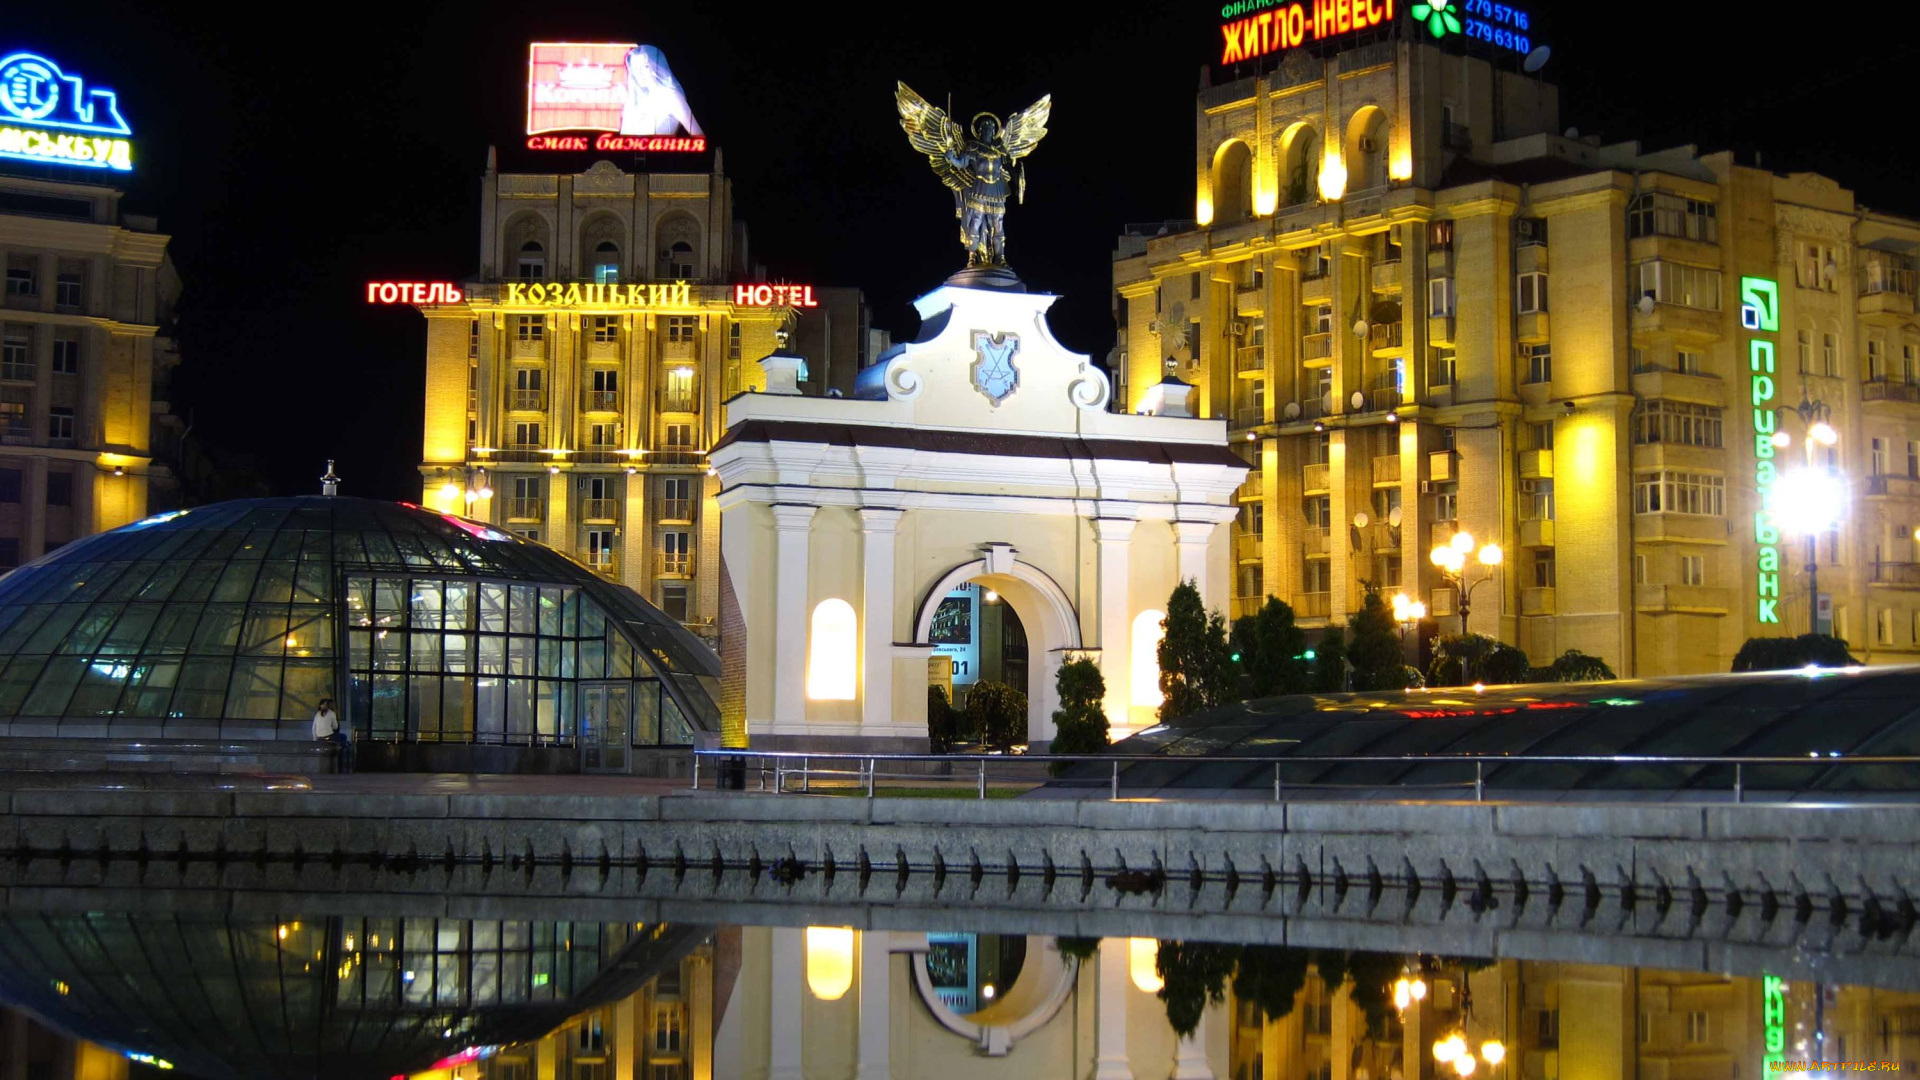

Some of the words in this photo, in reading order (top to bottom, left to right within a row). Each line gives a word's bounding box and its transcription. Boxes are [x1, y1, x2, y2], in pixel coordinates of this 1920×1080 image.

[1221, 0, 1284, 18] ФІНАНС
[1464, 0, 1491, 17] 279
[1494, 4, 1529, 30] 5716
[1465, 19, 1492, 42] 279
[1495, 28, 1530, 54] 6310
[527, 136, 588, 150] смак
[596, 133, 706, 151] бажання
[367, 282, 462, 303] ГОТЕЛЬ
[507, 279, 691, 307] КОЗАЦЬКИЙ
[736, 284, 818, 306] HOTEL
